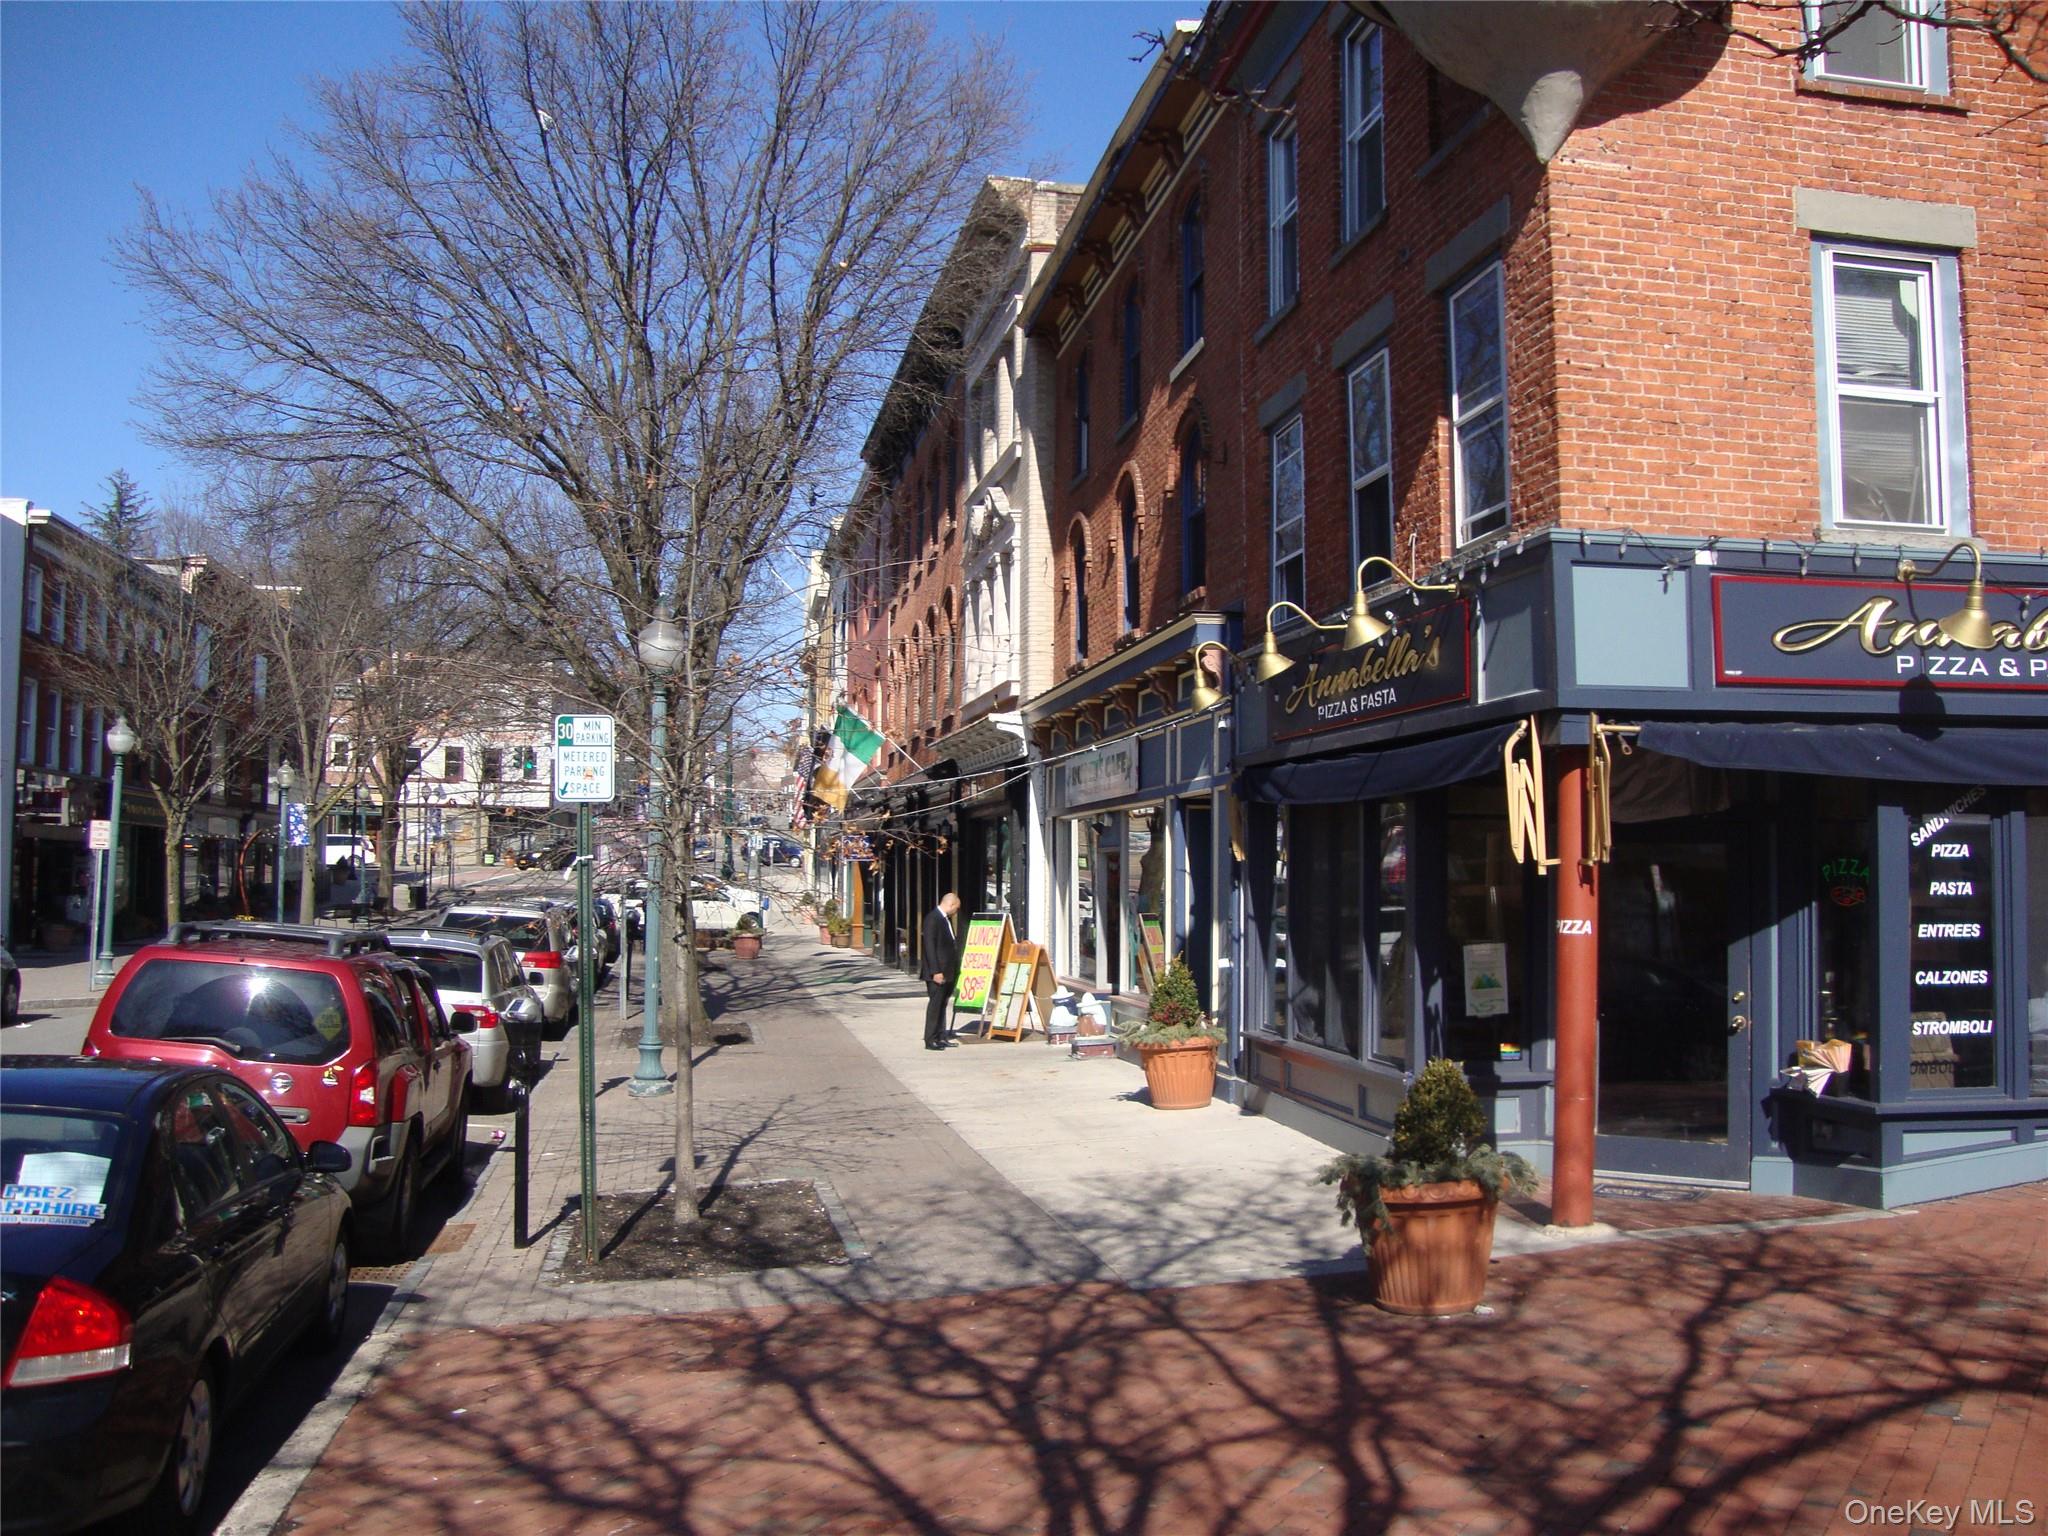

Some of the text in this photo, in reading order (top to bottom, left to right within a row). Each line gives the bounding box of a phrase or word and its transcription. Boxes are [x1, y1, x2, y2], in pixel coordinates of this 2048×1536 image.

[1772, 595, 2048, 655] Anab
[1285, 624, 1441, 714] Annabella's
[1896, 655, 2048, 678] PIZZA & P
[1318, 688, 1397, 720] PIZZA & PASTA
[559, 723, 573, 740] 30
[584, 721, 601, 730] MIN
[576, 733, 609, 744] PARKING
[563, 752, 607, 762] METERED
[564, 766, 605, 777] PARKNG
[570, 783, 600, 794] SPACE
[1910, 785, 1987, 847] SANDWICHES
[1931, 844, 1969, 857] PIZZA
[1822, 858, 1870, 884] PIZZA
[1929, 881, 1973, 896] PASTA
[968, 926, 1001, 946] LUNCH
[1917, 923, 1981, 938] ENTREES
[963, 952, 993, 970] SPECIAL
[1915, 970, 1988, 985] CALZONES
[1912, 1020, 1992, 1035] STROMBOLI
[4, 1185, 75, 1200] PREZ
[0, 1201, 105, 1218] PPHIRE
